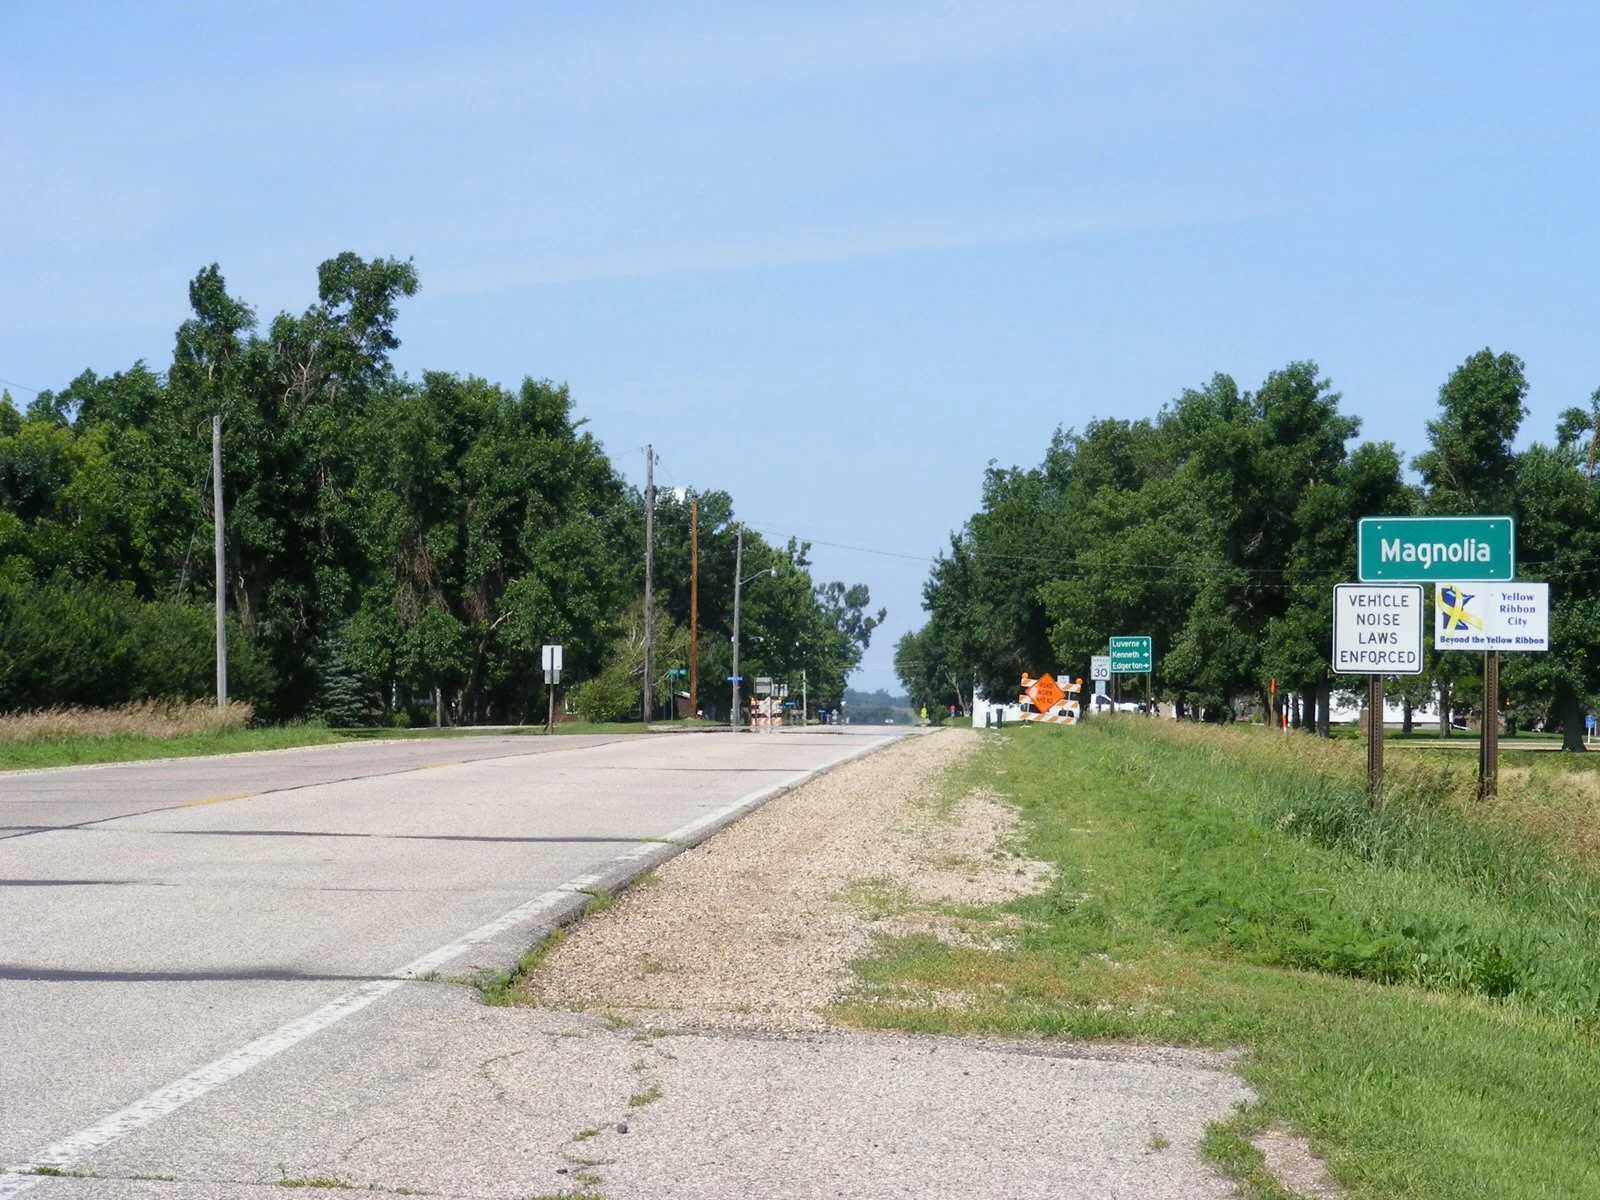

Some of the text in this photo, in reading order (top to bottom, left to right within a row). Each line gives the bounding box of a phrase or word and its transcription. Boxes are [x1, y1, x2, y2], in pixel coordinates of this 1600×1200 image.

[1381, 538, 1491, 569] Magnolia
[1349, 594, 1409, 607] VEHICLE
[1501, 592, 1534, 601] Yellow
[1500, 605, 1536, 613] Ribbon
[1356, 613, 1400, 626] NOISE
[1507, 617, 1527, 627] City
[1358, 632, 1398, 645] LAWS
[1440, 636, 1469, 645] Beyond
[1486, 636, 1512, 644] Yellow
[1515, 636, 1544, 644] Ribbon
[1112, 640, 1140, 648] Luverne
[1340, 650, 1416, 663] ENFORCED
[1112, 662, 1143, 671] Edgerton
[1094, 668, 1108, 677] 30
